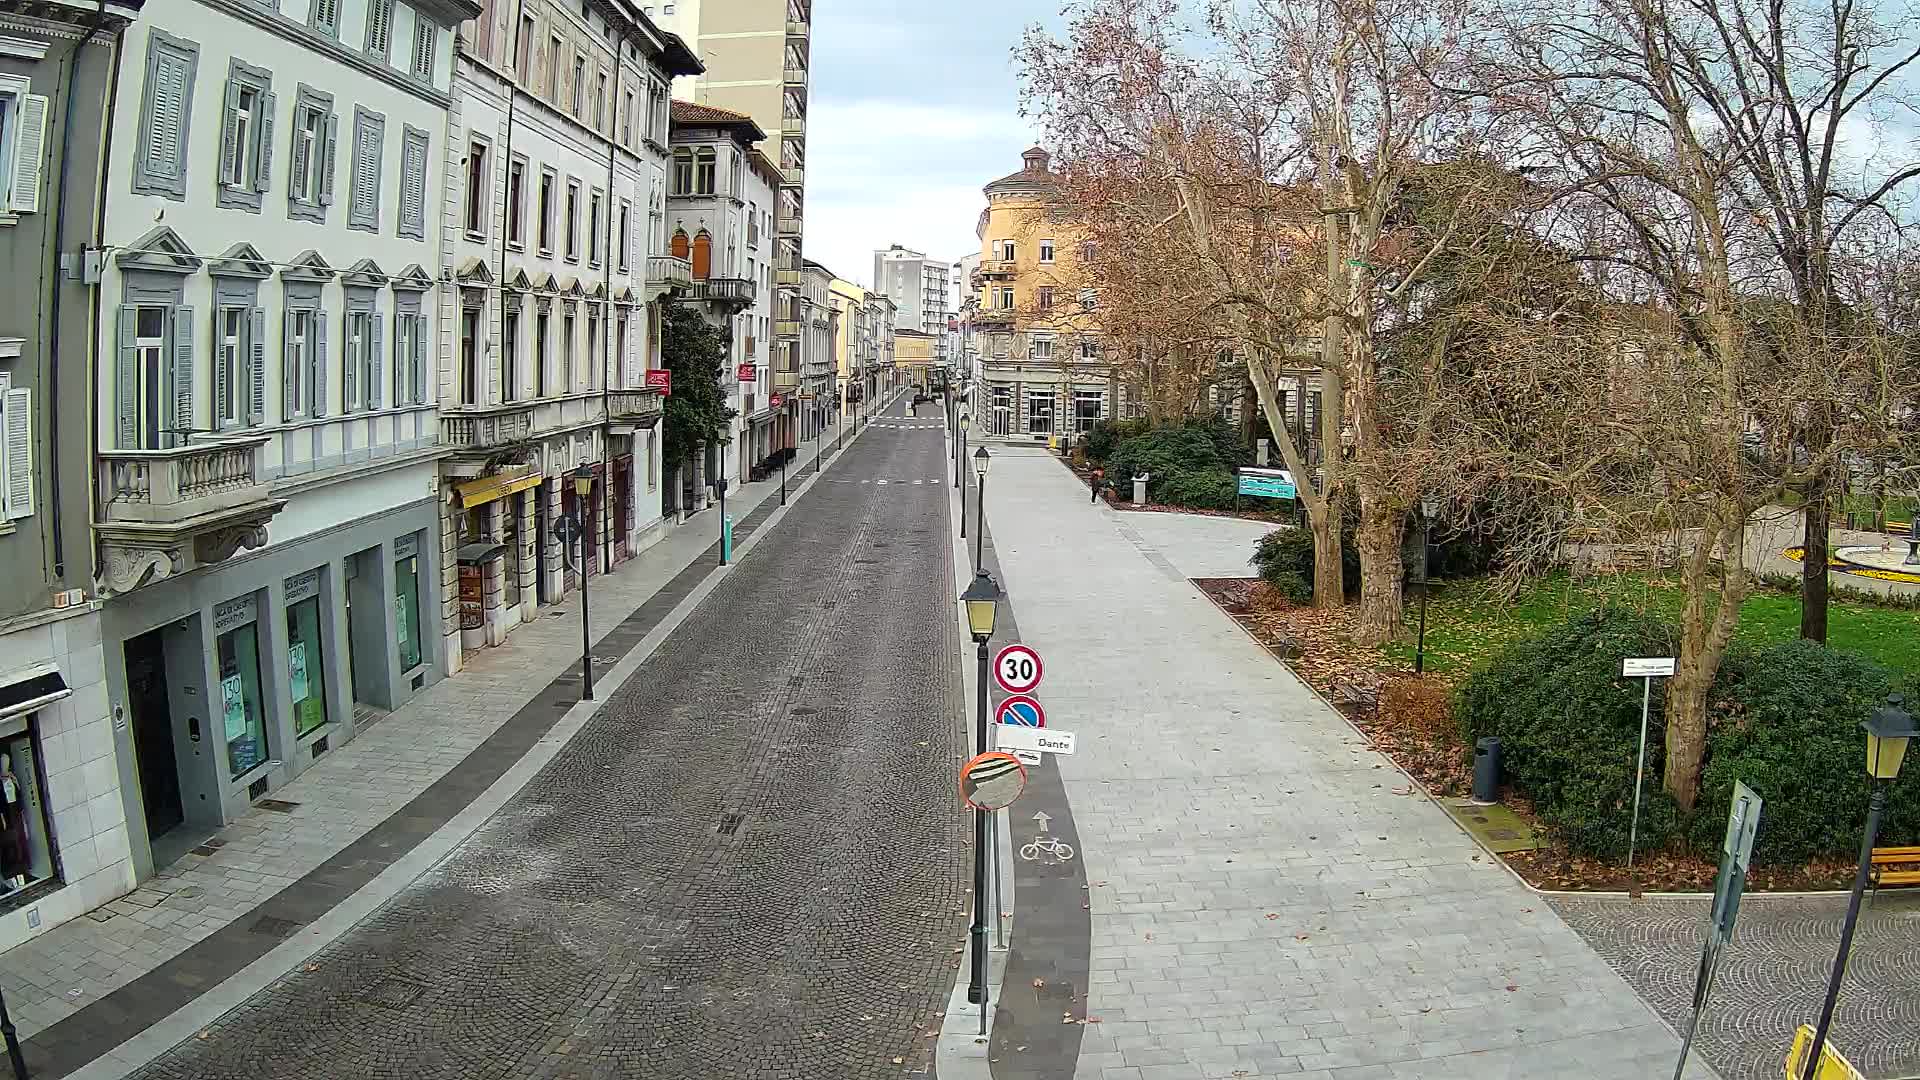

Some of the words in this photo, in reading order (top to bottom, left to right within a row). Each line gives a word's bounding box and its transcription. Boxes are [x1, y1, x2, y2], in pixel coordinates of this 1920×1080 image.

[1006, 658, 1033, 680] 30
[222, 677, 241, 701] 130
[1038, 738, 1070, 749] Dante
